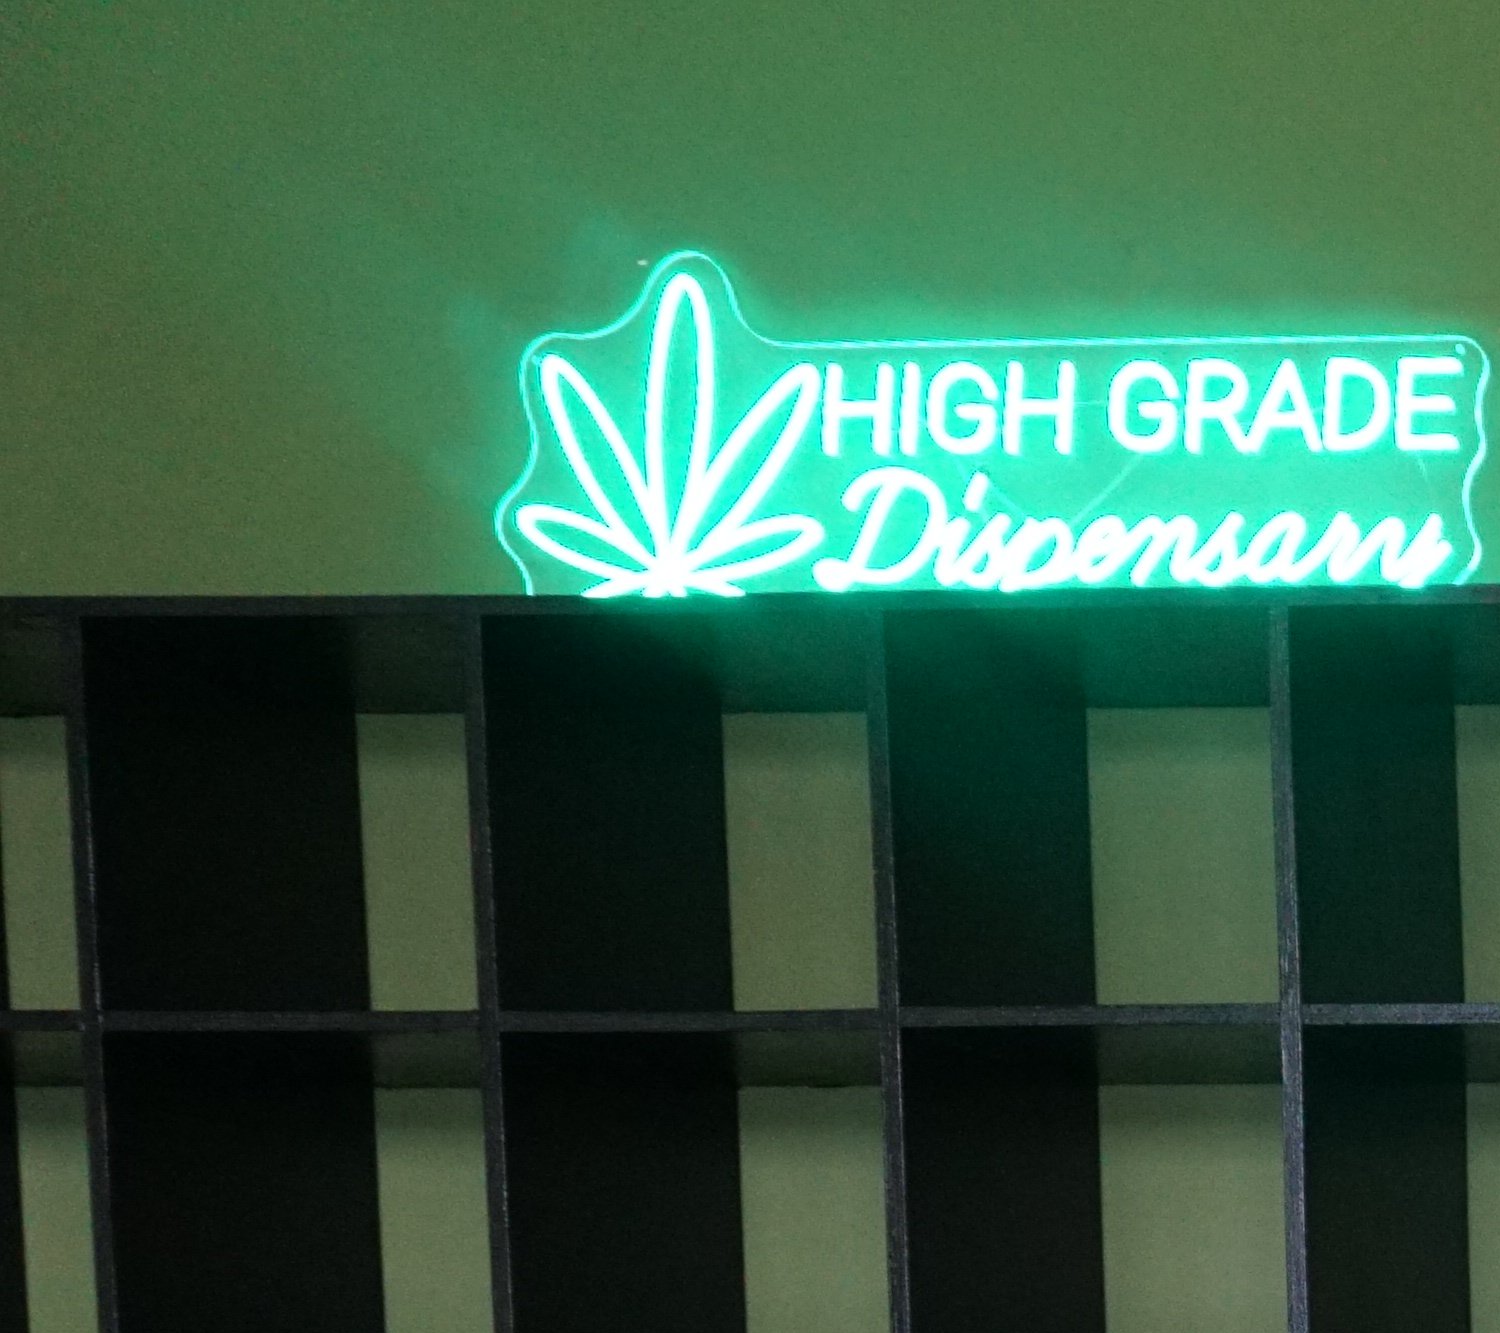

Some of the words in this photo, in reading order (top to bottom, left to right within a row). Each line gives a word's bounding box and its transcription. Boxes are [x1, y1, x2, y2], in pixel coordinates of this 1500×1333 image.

[820, 357, 1076, 458] HIGH
[1107, 355, 1466, 456] GRADE
[812, 464, 1456, 594] Dispensary
